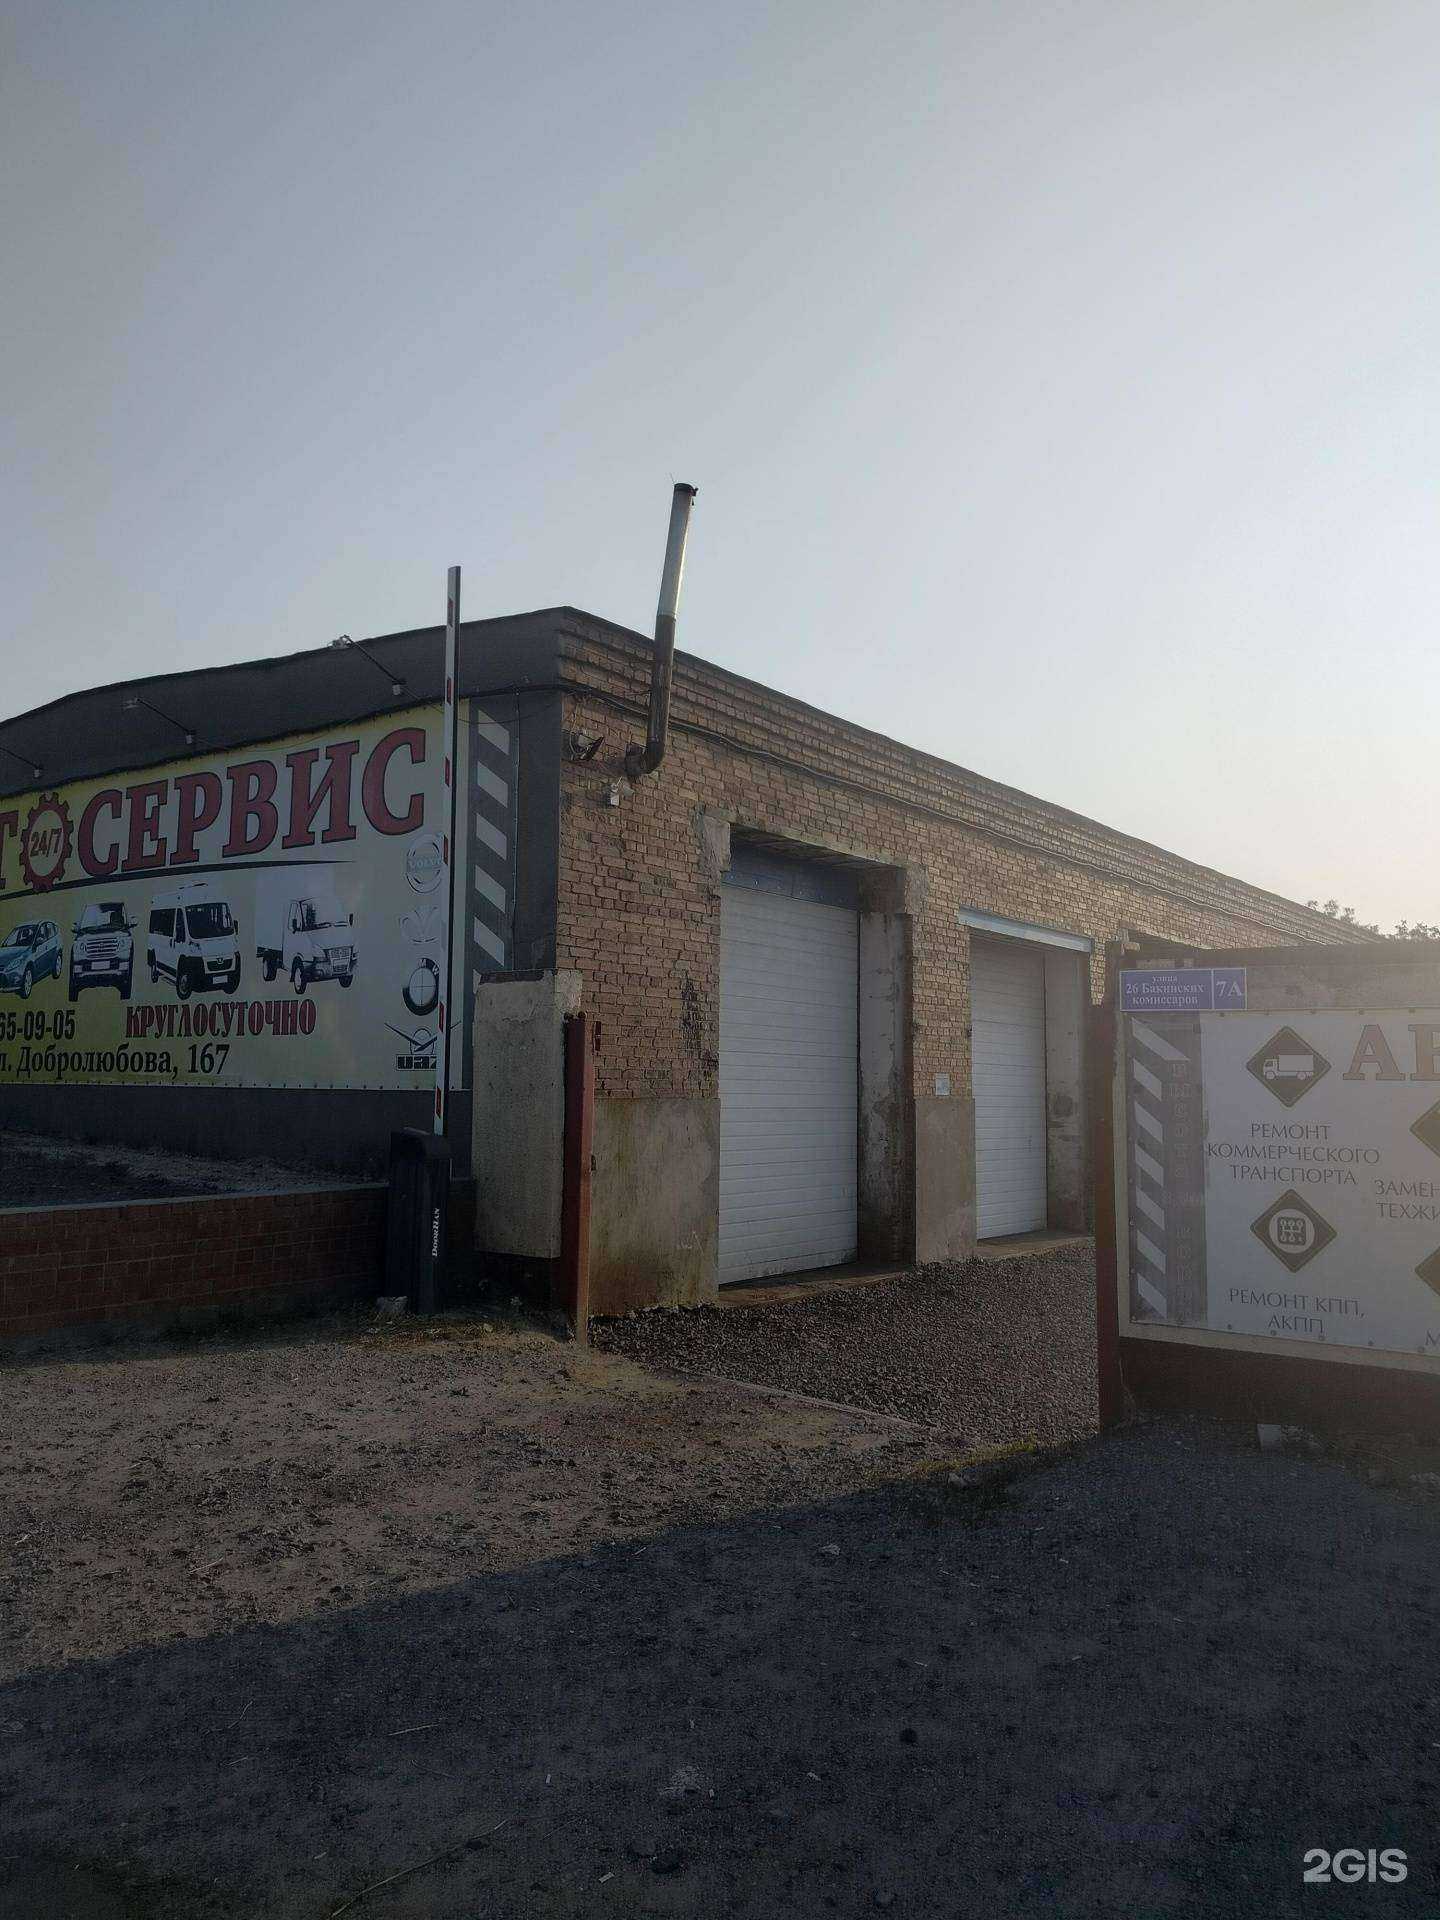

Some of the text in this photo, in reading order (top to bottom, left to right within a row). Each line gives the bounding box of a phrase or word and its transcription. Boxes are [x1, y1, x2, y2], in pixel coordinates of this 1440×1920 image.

[77, 727, 426, 877] СЕРВИС
[30, 828, 63, 857] 24/7
[1126, 983, 1204, 994] 26 Бакинских
[1216, 981, 1243, 997] 7А
[1132, 995, 1198, 1007] комиссаров
[126, 999, 317, 1039] КРУГЛОСУТОЧНО
[17, 1042, 179, 1080] Добролюбова,
[188, 1041, 230, 1075] 167
[1250, 1122, 1331, 1140] РЕМОНТ
[1208, 1142, 1380, 1164] КОММЕРЧЕСКОГО
[1231, 1164, 1357, 1185] ТРАНСПОРТА
[1229, 1288, 1366, 1318] РЕМОНТ КПП,
[1268, 1314, 1324, 1333] АКПП
